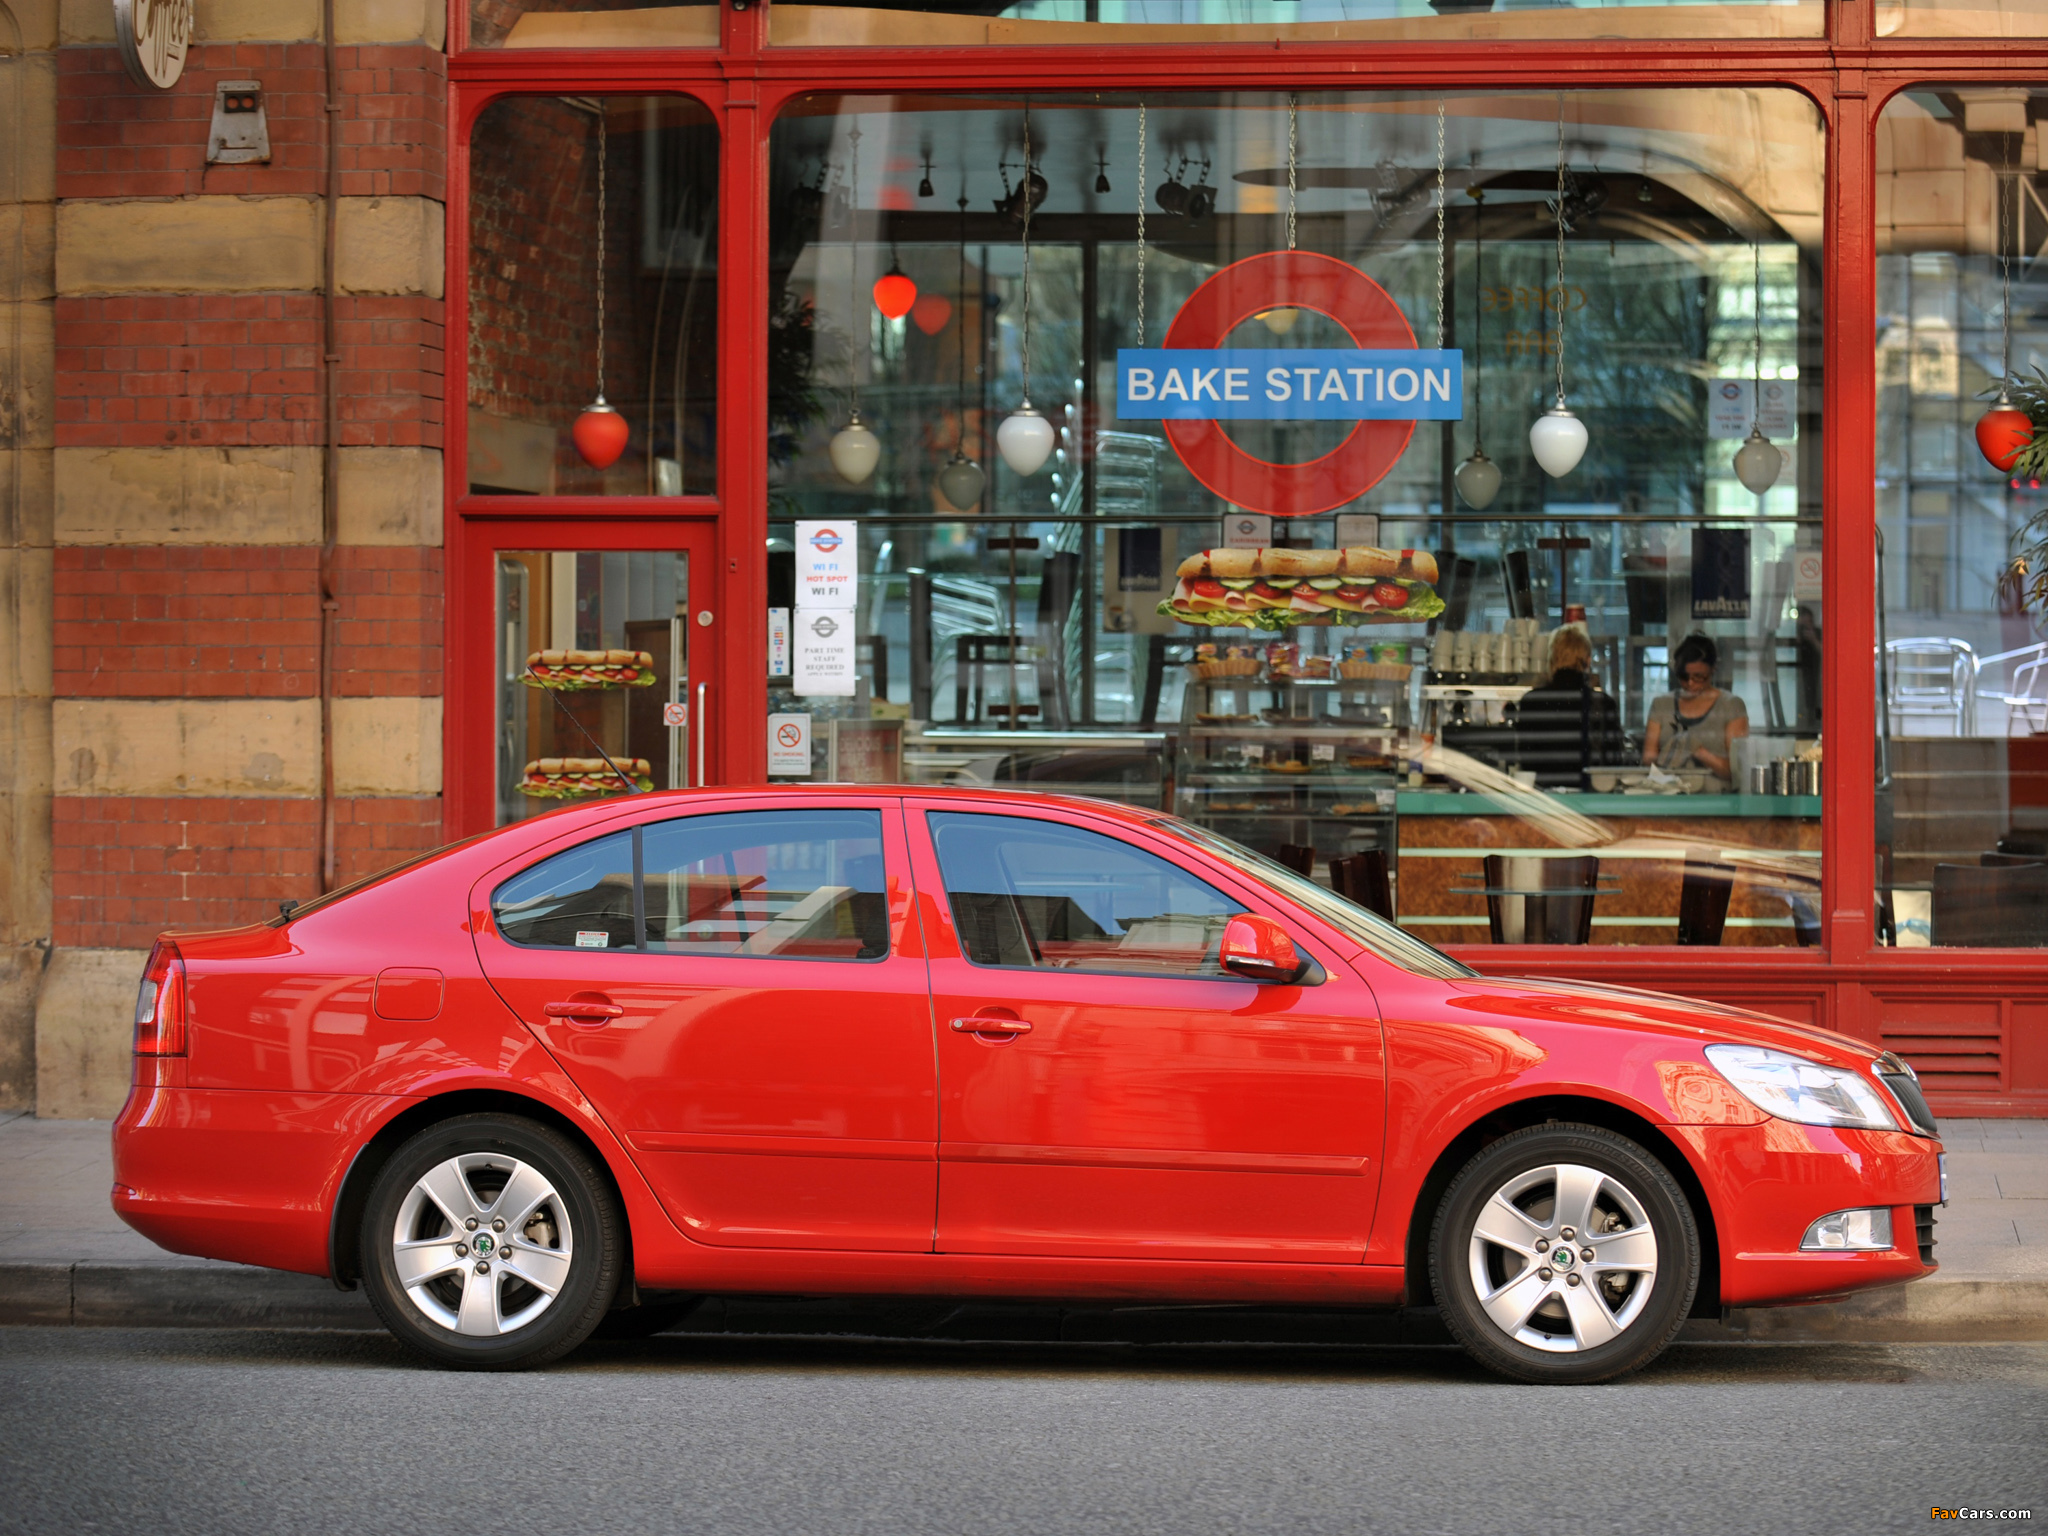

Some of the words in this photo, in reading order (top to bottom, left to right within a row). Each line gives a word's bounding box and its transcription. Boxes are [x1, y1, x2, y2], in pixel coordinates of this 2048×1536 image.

[1128, 367, 1250, 401] BAKE
[1265, 367, 1450, 402] STATION
[811, 587, 825, 595] WI
[828, 587, 839, 595] FI
